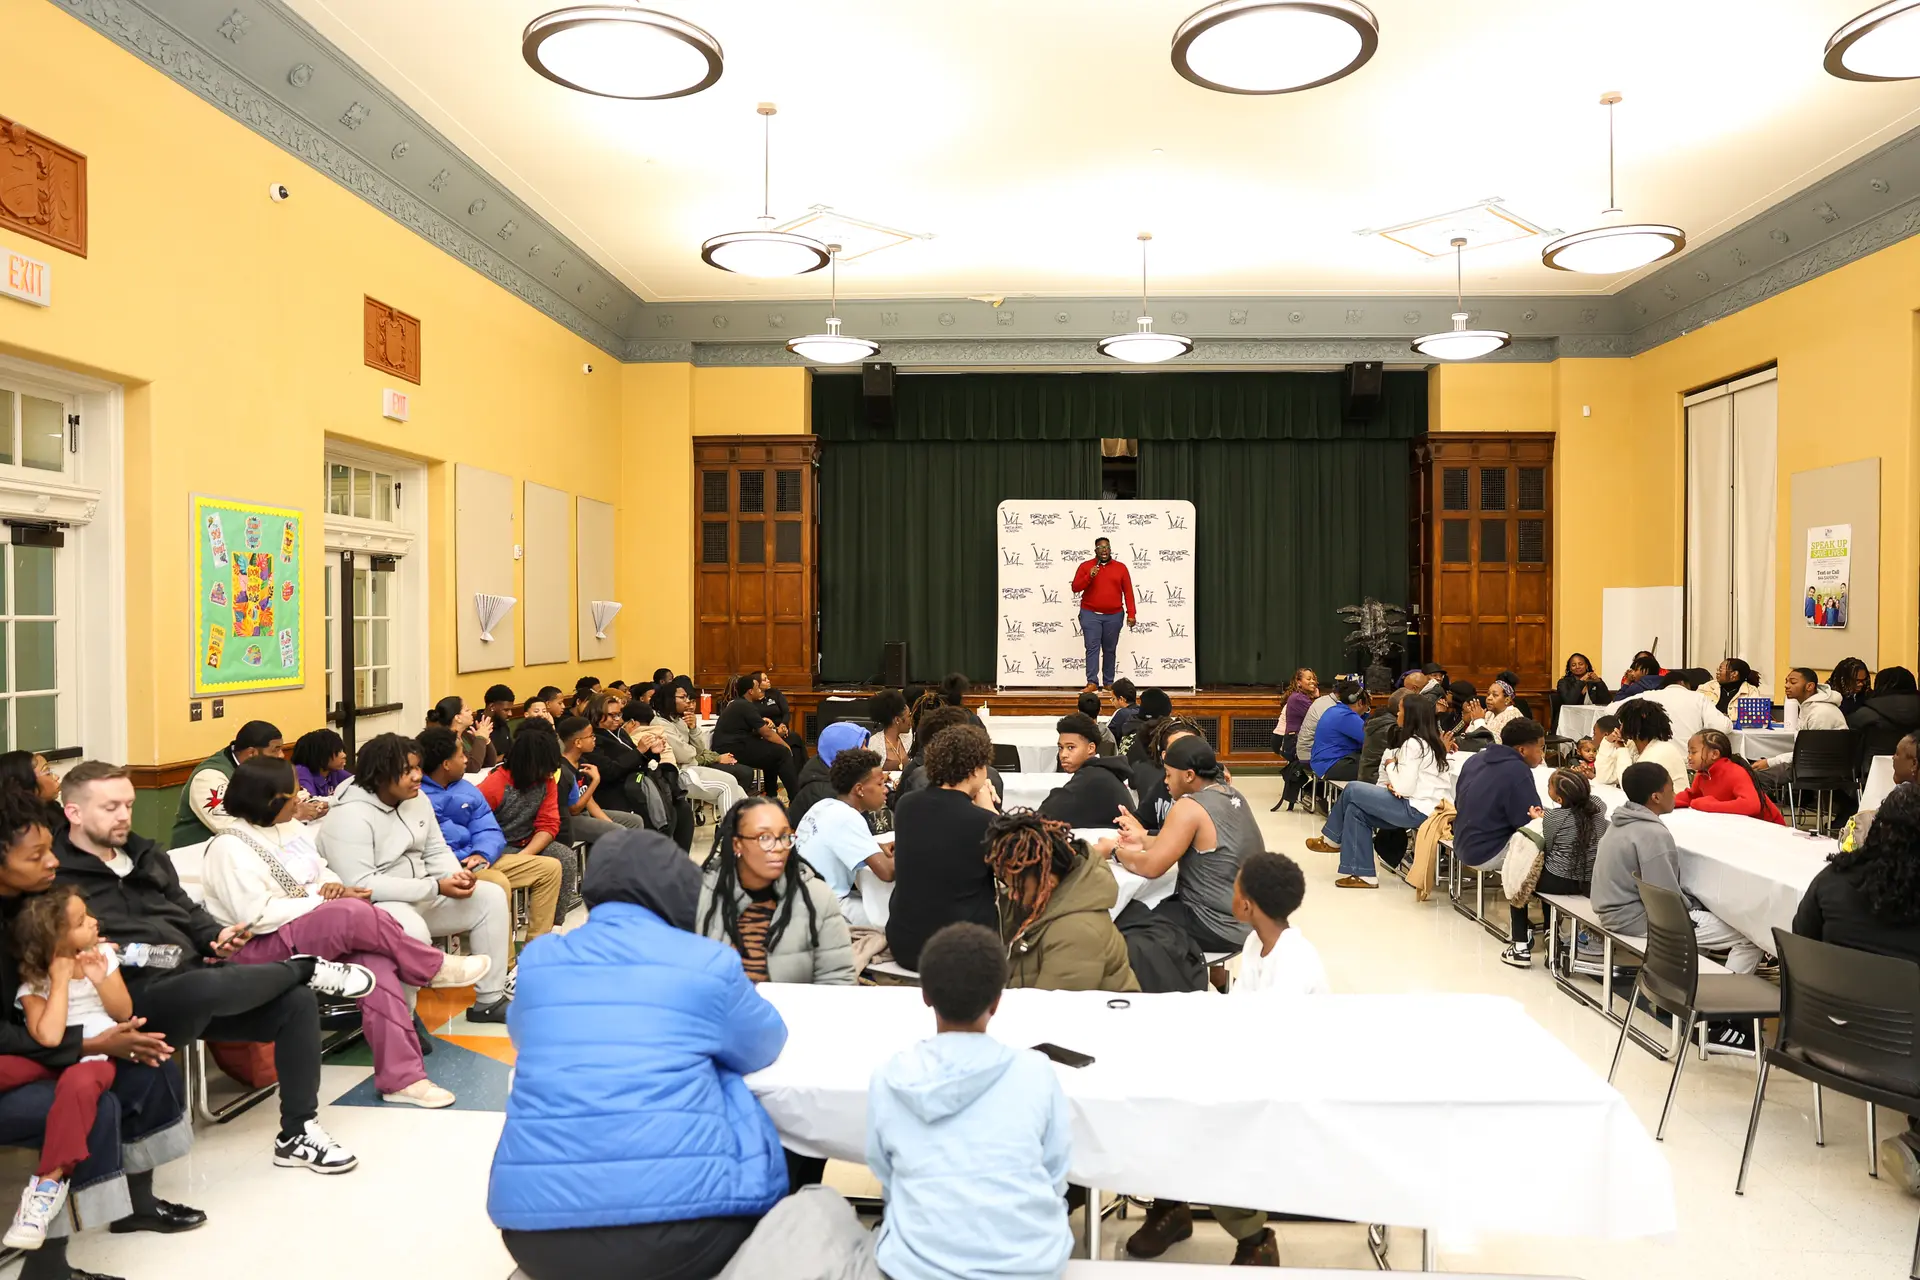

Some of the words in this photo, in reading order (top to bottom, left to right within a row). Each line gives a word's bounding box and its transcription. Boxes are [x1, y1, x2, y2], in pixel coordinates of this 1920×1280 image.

[9, 254, 43, 297] EXIT
[1811, 540, 1835, 550] SPEAK
[1838, 540, 1847, 548] UP
